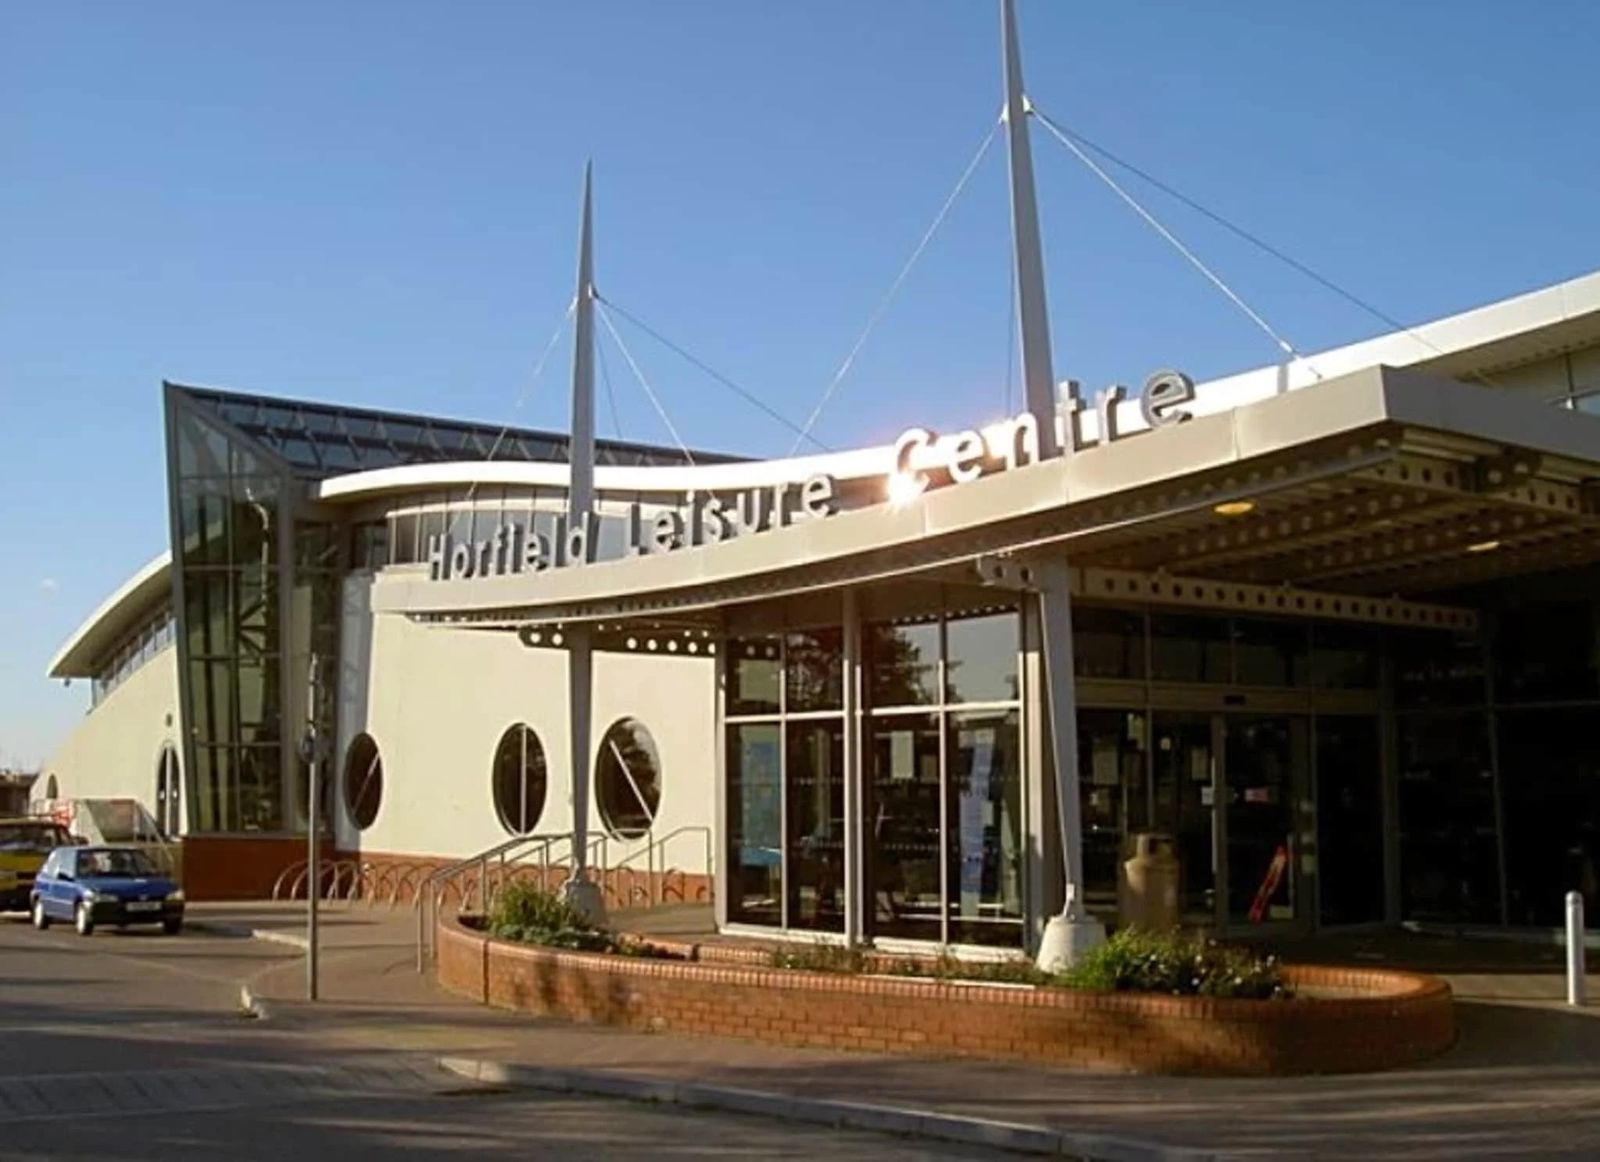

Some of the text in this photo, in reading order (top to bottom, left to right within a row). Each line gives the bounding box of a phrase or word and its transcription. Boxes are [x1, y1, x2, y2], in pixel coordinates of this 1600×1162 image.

[427, 369, 1194, 581] Horfield Leisure Centre
